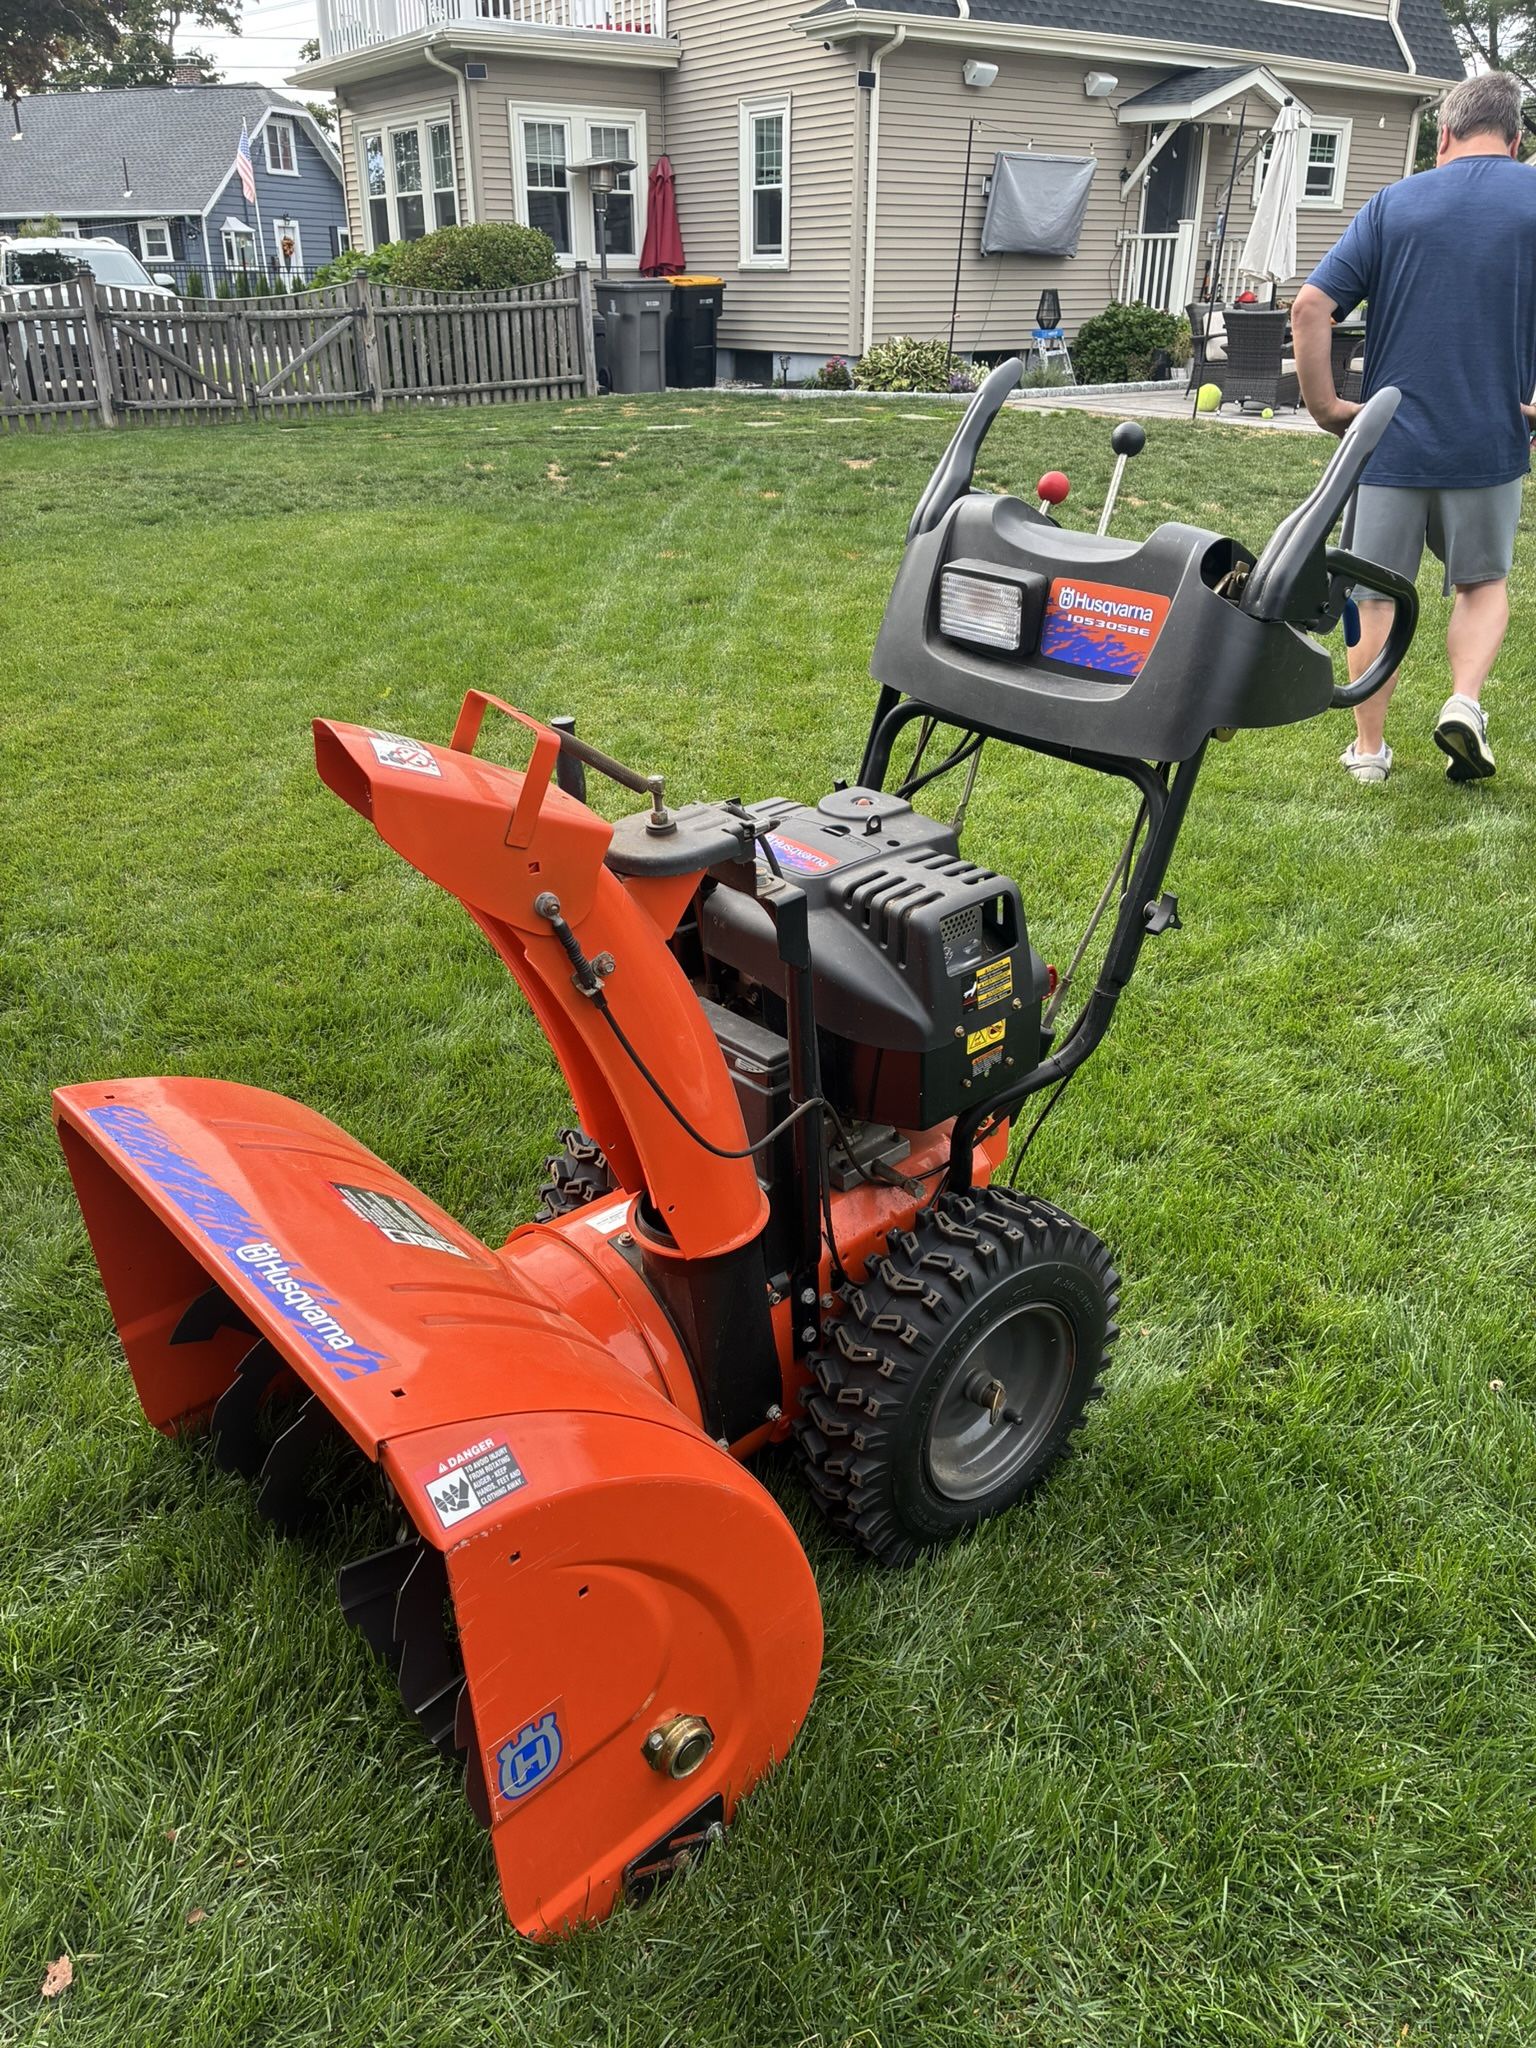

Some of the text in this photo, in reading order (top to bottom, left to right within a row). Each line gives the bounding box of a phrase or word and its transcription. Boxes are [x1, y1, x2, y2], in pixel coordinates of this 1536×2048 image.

[1074, 591, 1154, 622] Husqvarna
[254, 1258, 354, 1350] Husqvarna
[447, 1437, 495, 1468] DANGER
[464, 1464, 474, 1474] TO
[473, 1455, 490, 1470] AVOID
[468, 1455, 511, 1482] FROM ROTATING
[473, 1475, 492, 1489] AUGER
[493, 1466, 508, 1477] KEEP
[496, 1474, 510, 1487] FEET
[509, 1468, 521, 1479] AND
[480, 1486, 508, 1506] CLOTHING
